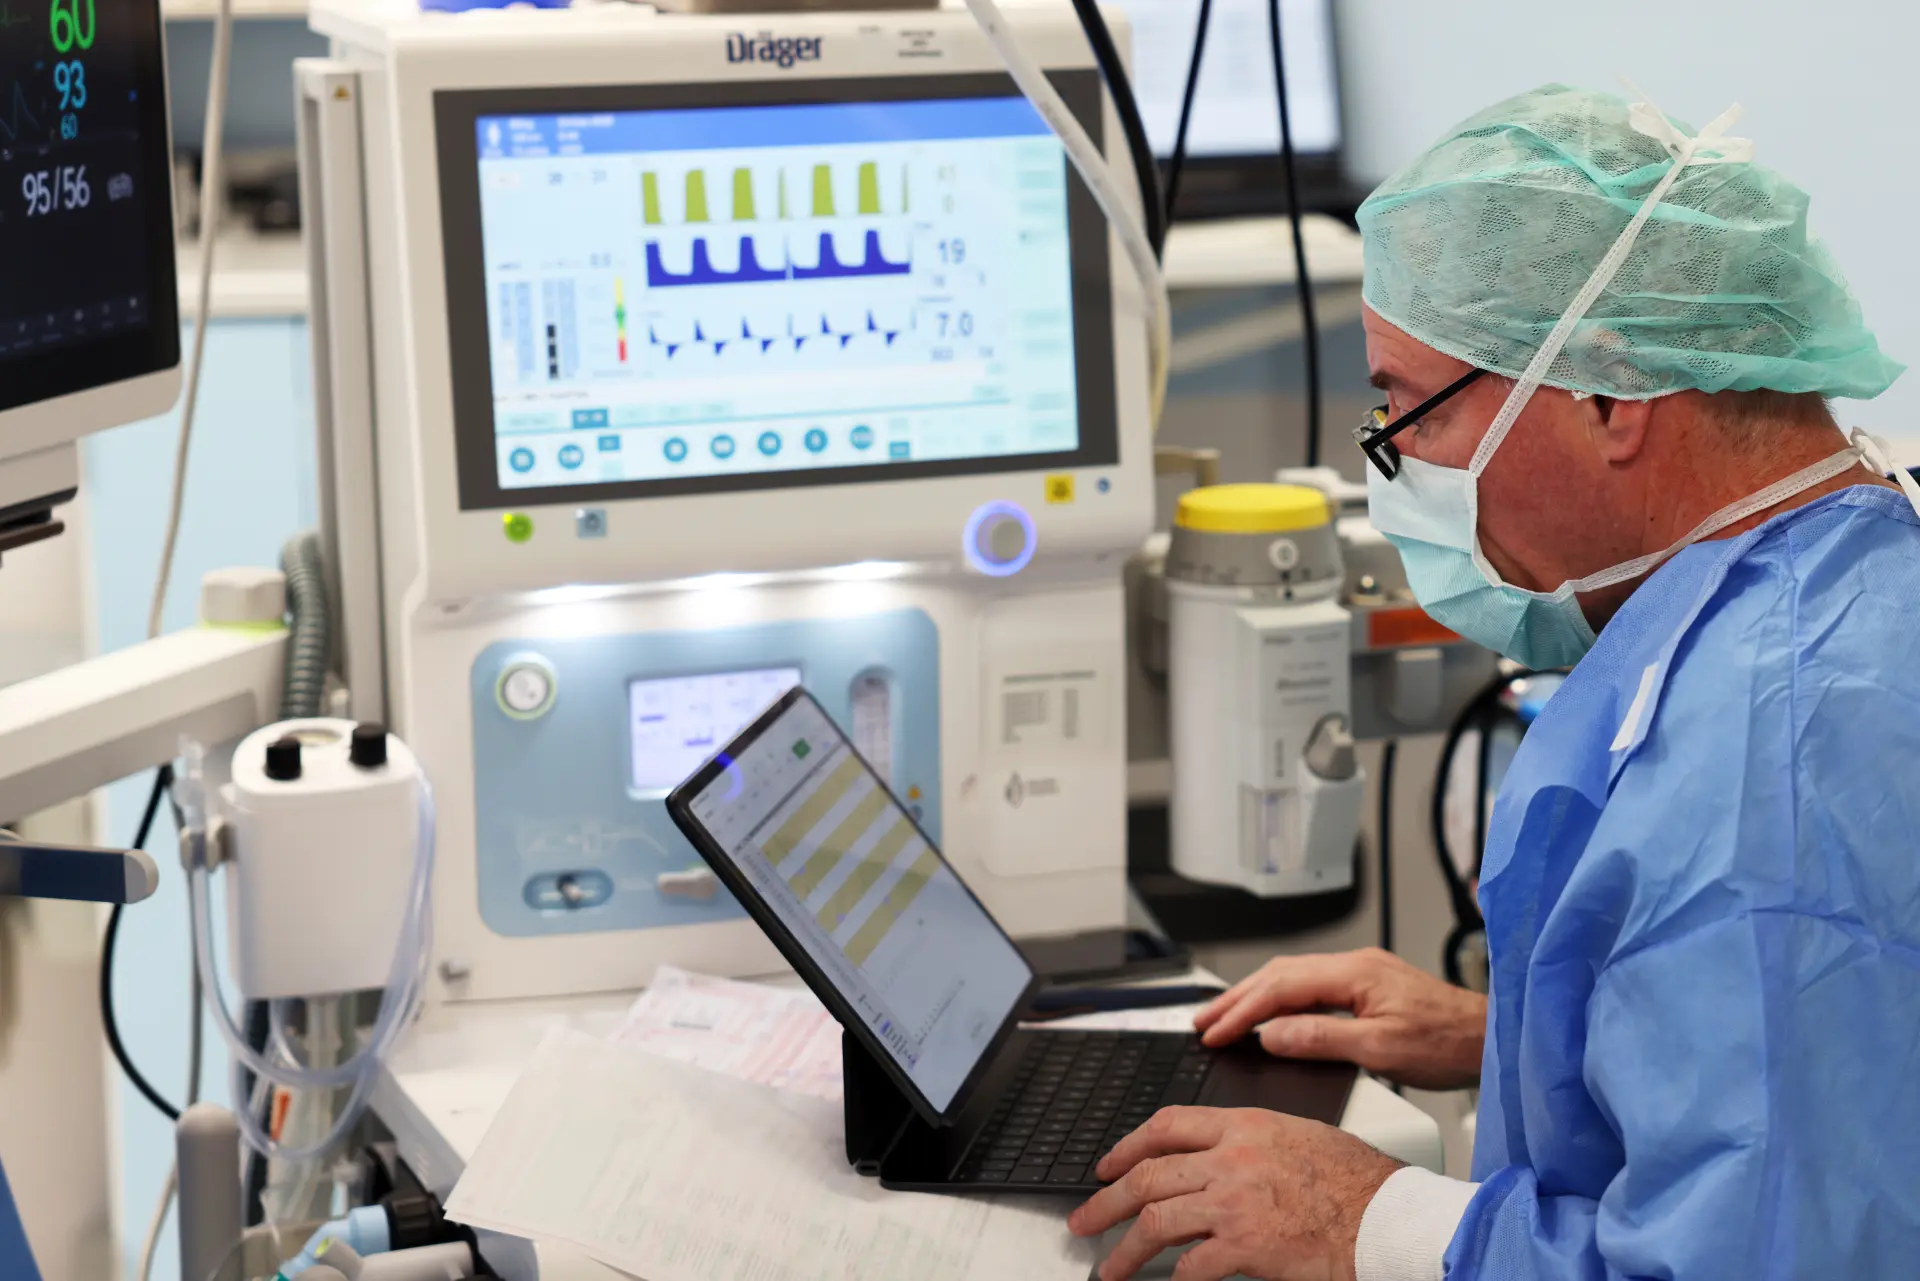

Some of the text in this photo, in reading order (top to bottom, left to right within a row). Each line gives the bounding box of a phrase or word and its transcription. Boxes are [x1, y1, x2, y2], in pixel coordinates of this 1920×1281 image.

[50, 0, 95, 52] 60
[727, 32, 823, 68] Dräger
[54, 60, 87, 110] 93
[61, 113, 78, 139] 60
[22, 165, 90, 216] 95/56
[938, 237, 966, 264] 19
[937, 311, 974, 338] 7.0
